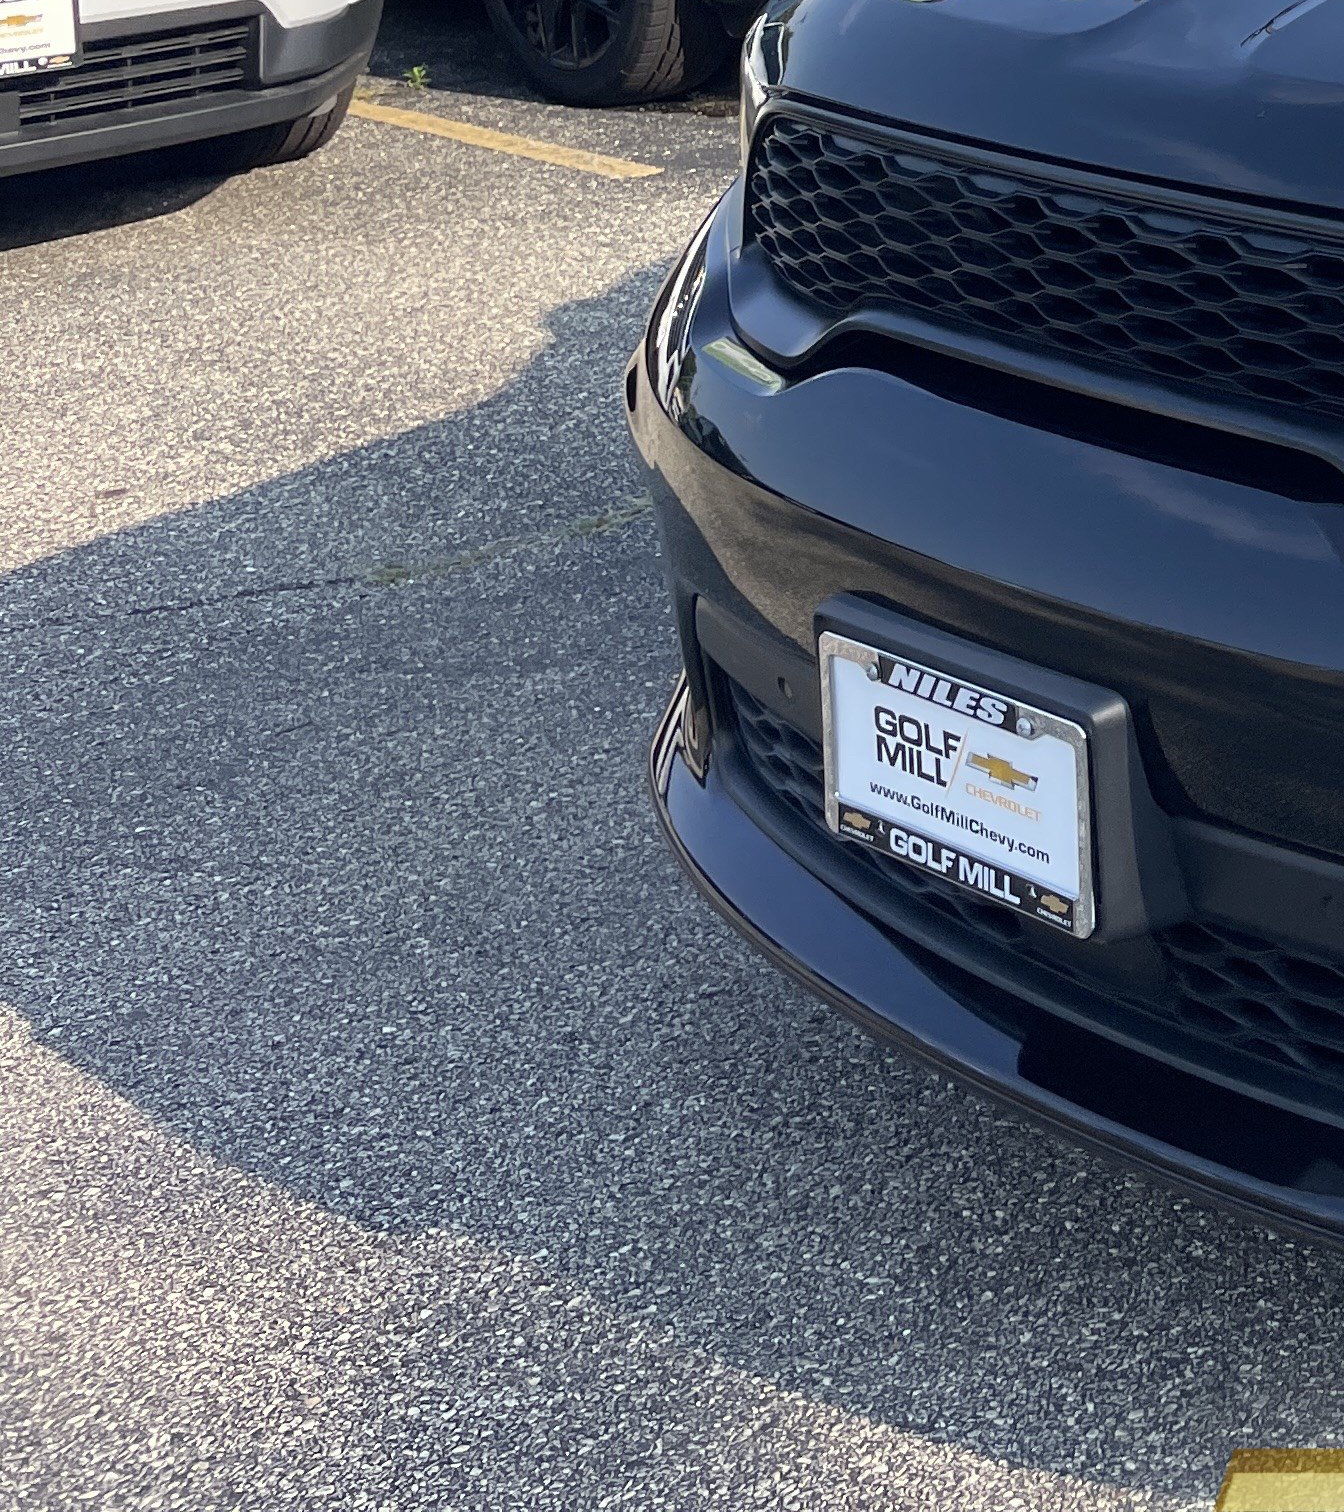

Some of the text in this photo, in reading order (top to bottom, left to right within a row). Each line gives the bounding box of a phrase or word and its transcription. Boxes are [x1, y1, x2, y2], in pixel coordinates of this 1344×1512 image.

[887, 662, 1009, 726] NILES
[873, 705, 962, 759] GOLF
[875, 734, 951, 788] MILL
[869, 781, 1050, 864] www.GolfMillChevy.com
[965, 782, 1042, 823] CHEVROLET
[889, 827, 1021, 905] GOLF MILL
